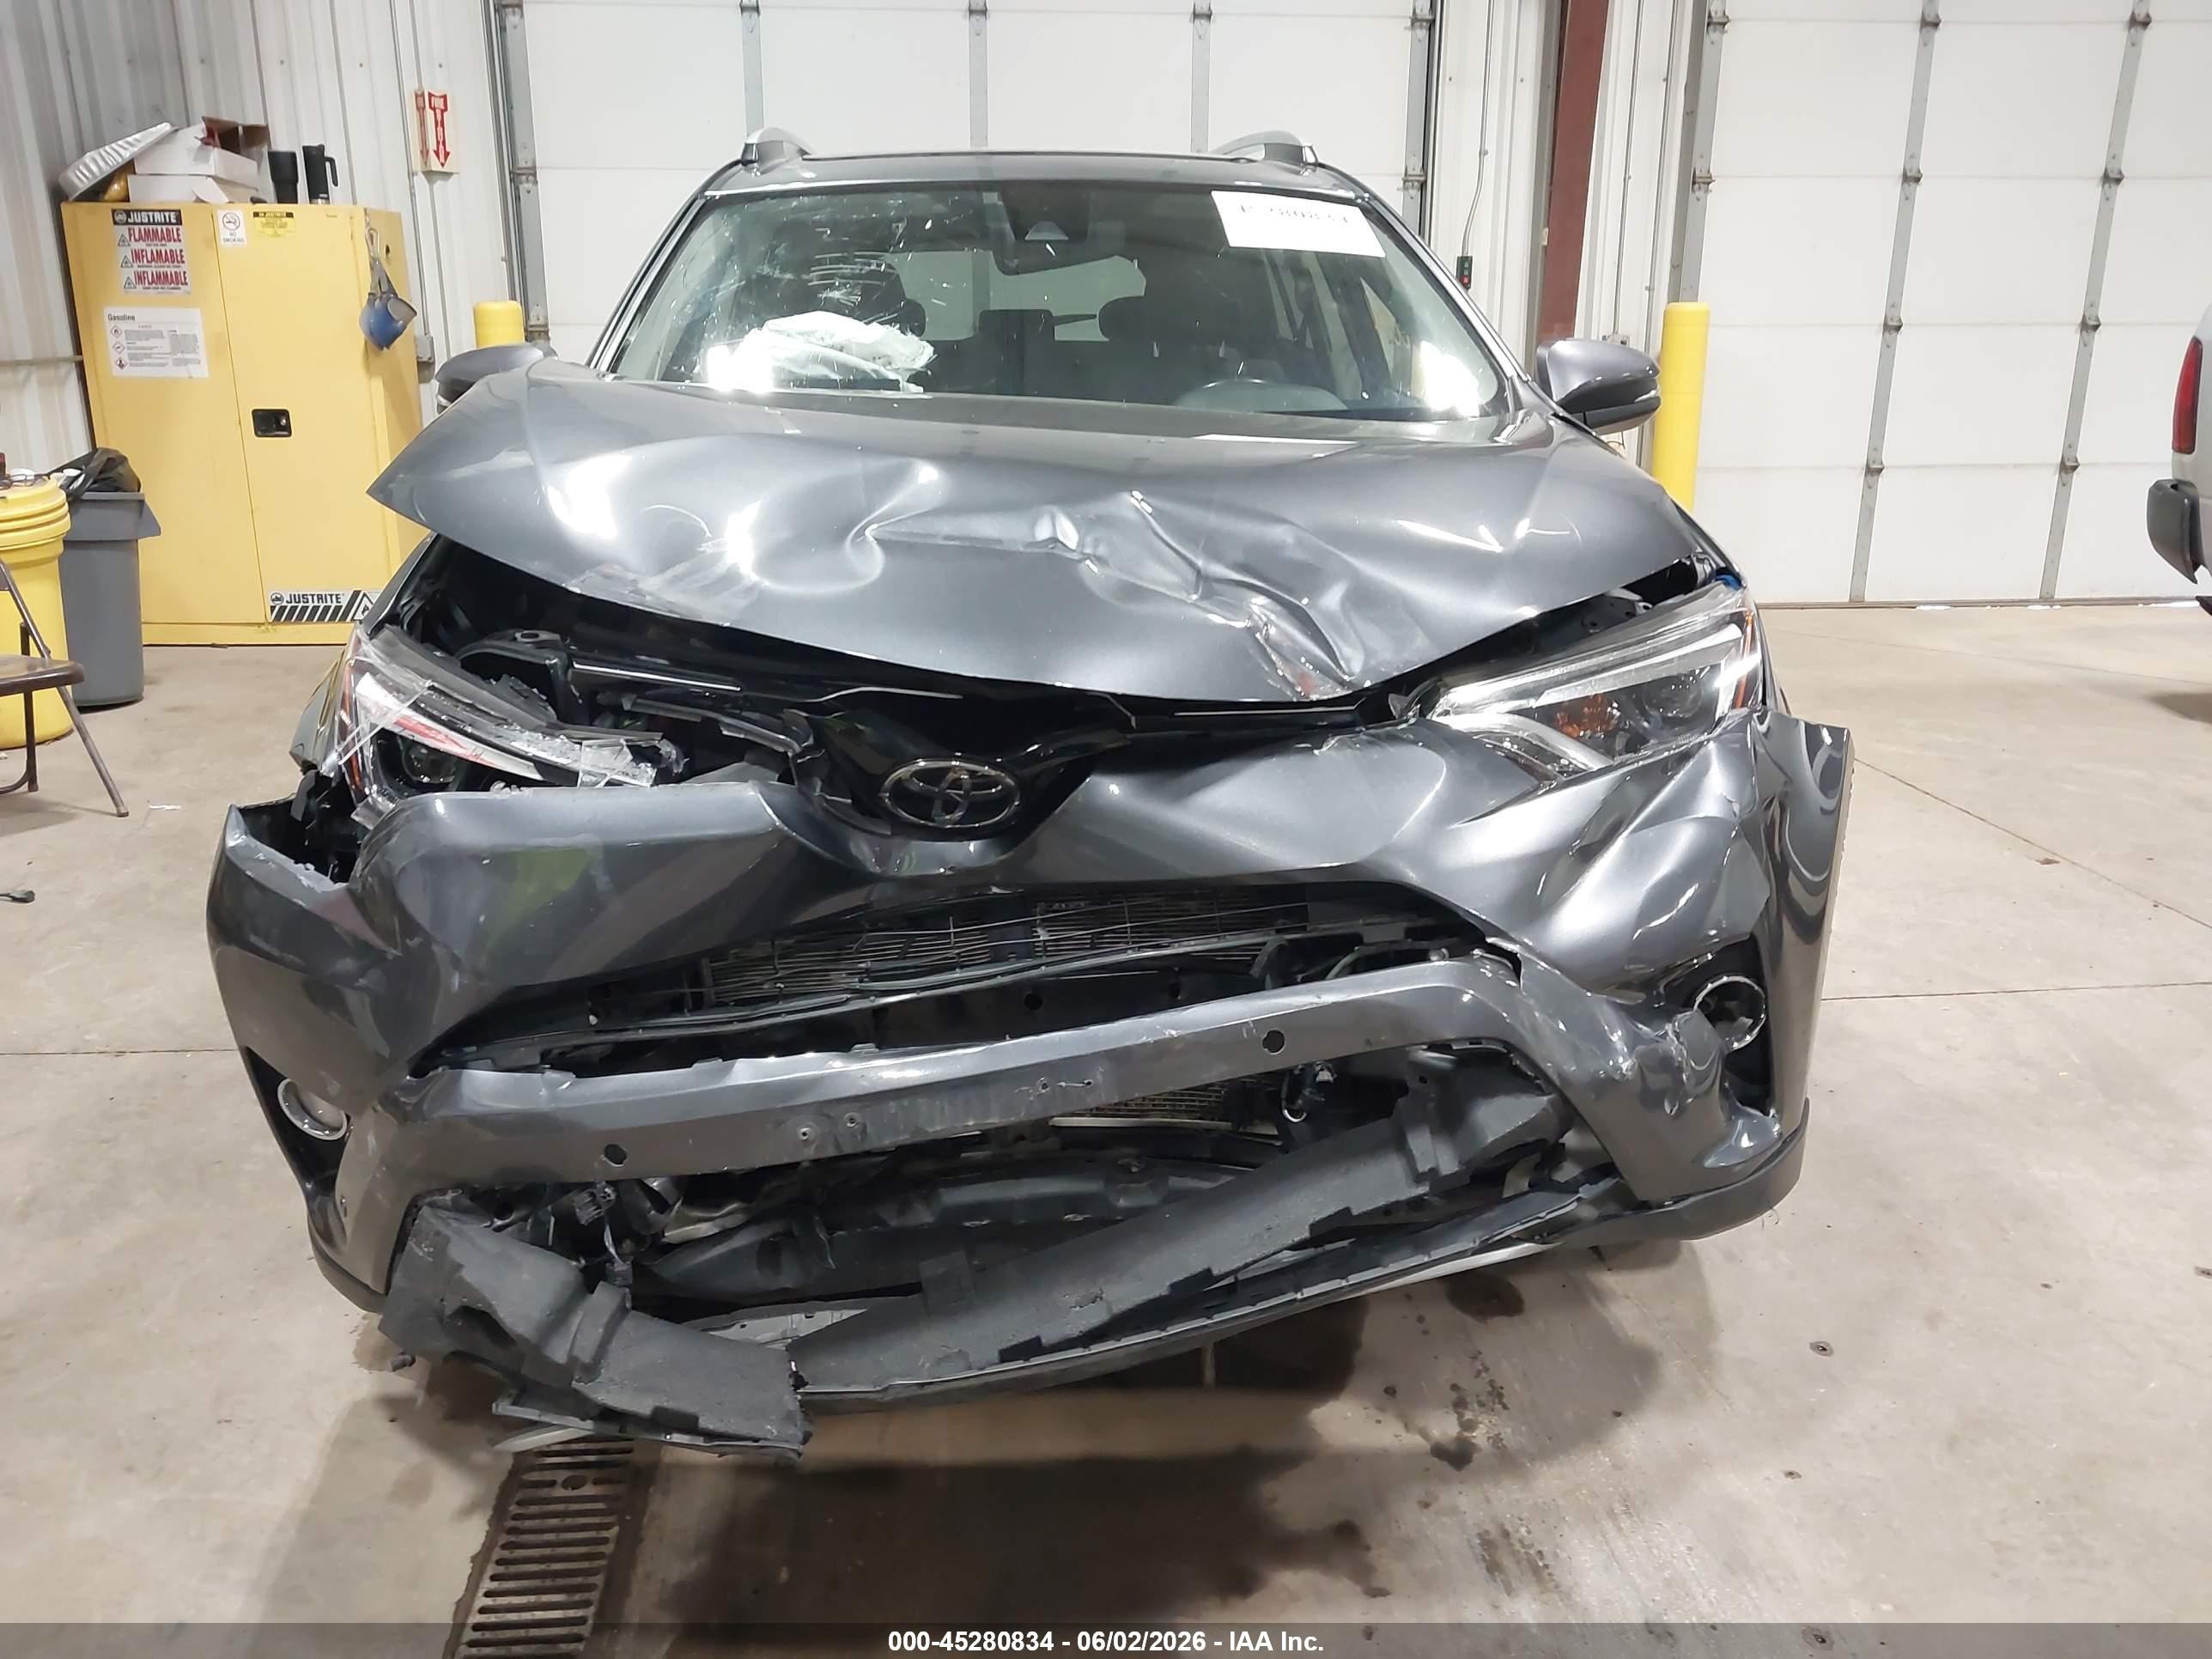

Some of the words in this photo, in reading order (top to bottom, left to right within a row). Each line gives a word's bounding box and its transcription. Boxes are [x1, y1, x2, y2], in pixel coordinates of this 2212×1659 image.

[128, 211, 177, 223] JUSTRITE
[128, 227, 182, 243] FLAMMABLE
[131, 248, 185, 264] INFLAMABLE
[133, 270, 188, 286] INFLAMMABLE
[107, 313, 136, 321] Gasoline
[286, 593, 342, 604] JUSTRITE
